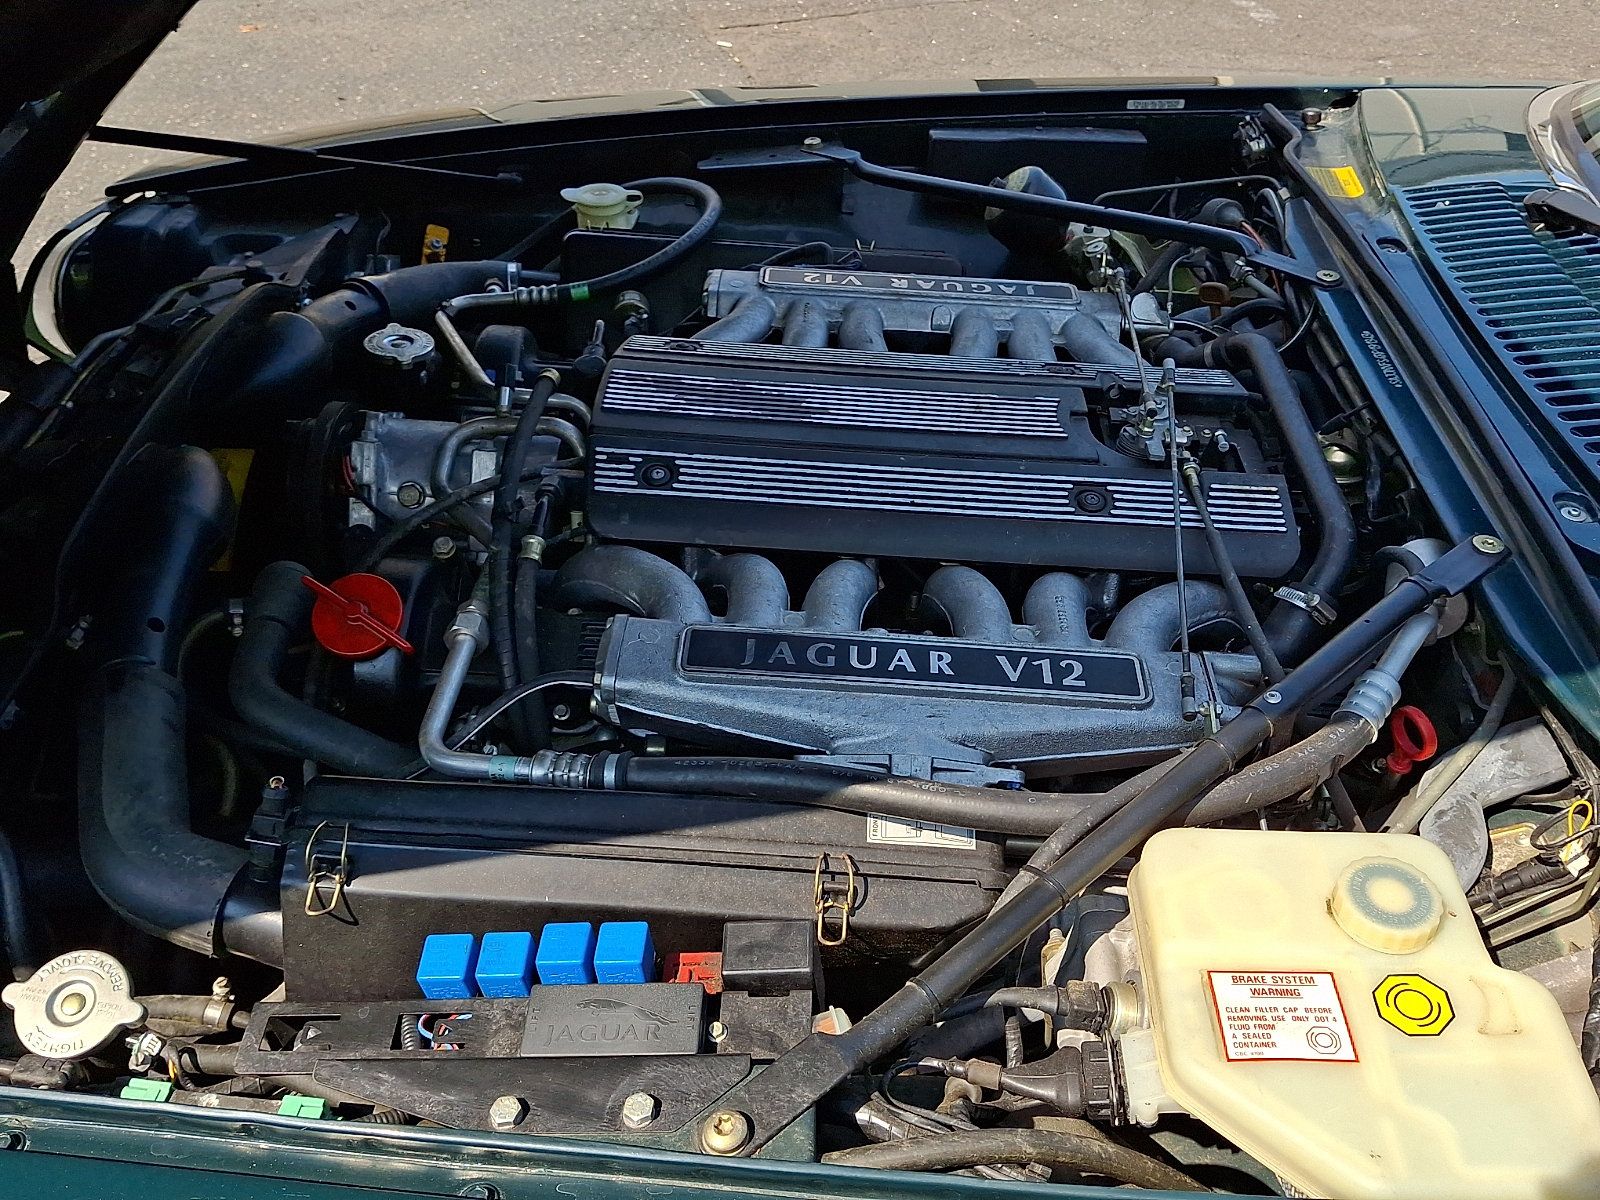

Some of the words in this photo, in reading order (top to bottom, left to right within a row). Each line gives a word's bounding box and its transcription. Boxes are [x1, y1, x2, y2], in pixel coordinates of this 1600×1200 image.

[803, 272, 863, 286] V12
[890, 278, 1035, 295] JAGUAR
[740, 638, 955, 675] JAGUAR
[994, 655, 1086, 687] V12
[37, 955, 87, 982] SLOWLY
[88, 955, 124, 992] REMOVE
[1231, 975, 1267, 984] BRAKE
[1272, 975, 1316, 985] SYSTEM
[1250, 988, 1301, 997] WARNING
[687, 1004, 696, 1030] LIFT
[1225, 1006, 1250, 1014] CLEAN
[1229, 1023, 1250, 1031] FLUID
[1253, 1023, 1276, 1031] FROM
[543, 1024, 661, 1047] JAGUAR
[1242, 1032, 1272, 1040] SEALED
[1233, 1041, 1278, 1049] CONTAINER
